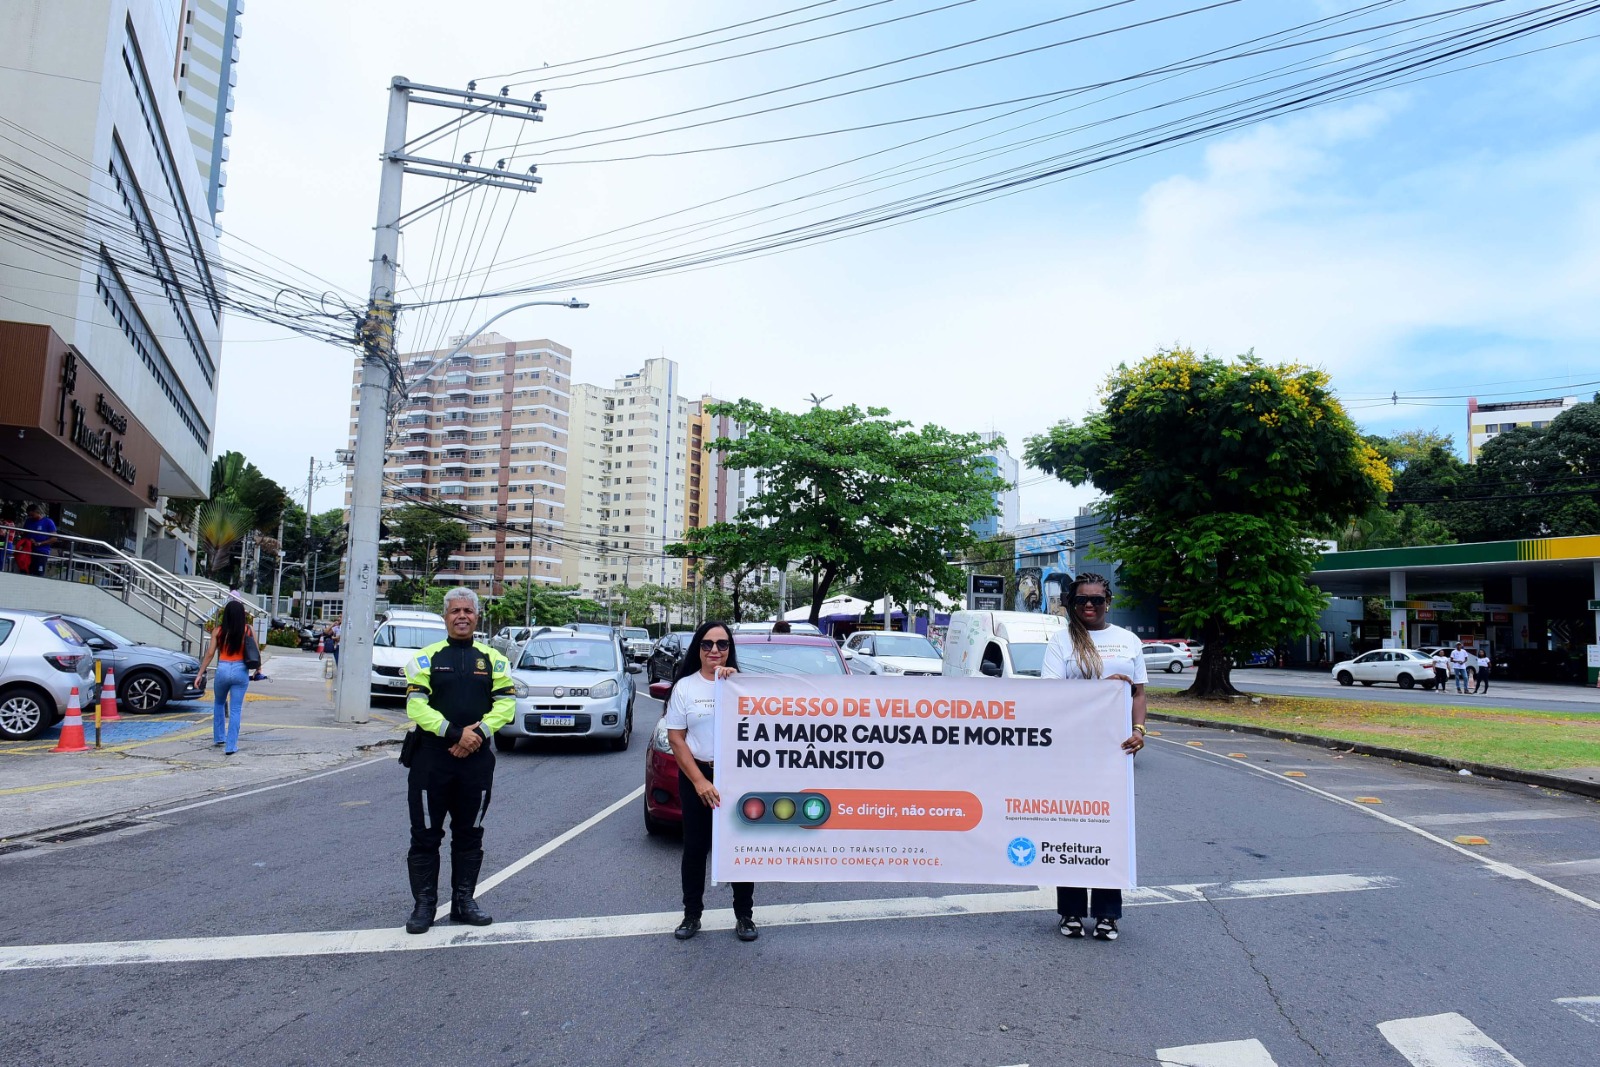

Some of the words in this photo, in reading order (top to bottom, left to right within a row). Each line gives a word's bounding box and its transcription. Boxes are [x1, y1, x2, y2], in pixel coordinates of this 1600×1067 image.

[738, 696, 838, 716] EXCESSO
[842, 698, 870, 717] DE
[876, 698, 1016, 720] VELOCIDADE
[737, 717, 750, 742] É
[754, 723, 770, 742] A
[774, 724, 848, 743] MAIOR
[852, 724, 928, 744] CAUSA
[932, 726, 960, 744] DE
[964, 726, 1052, 746] MORTES
[736, 749, 770, 768] NO
[776, 744, 884, 769] TRÂNSITO
[838, 804, 854, 815] Se
[857, 804, 898, 818] dirigir,
[901, 804, 926, 816] não
[929, 807, 966, 817] corra.
[1004, 798, 1110, 816] TRANSALVADOR
[850, 845, 898, 854] TRÂNSITO
[1041, 842, 1102, 854] Prefeitura
[734, 857, 741, 865] A
[744, 857, 764, 865] PAZ
[767, 857, 783, 865] NO
[786, 856, 838, 865] TRÂNSITO
[841, 857, 885, 867] COMEÇA
[888, 858, 909, 866] POR
[912, 856, 943, 866] VOCÊ.
[1042, 854, 1056, 864] de
[1060, 854, 1110, 866] Salvador
